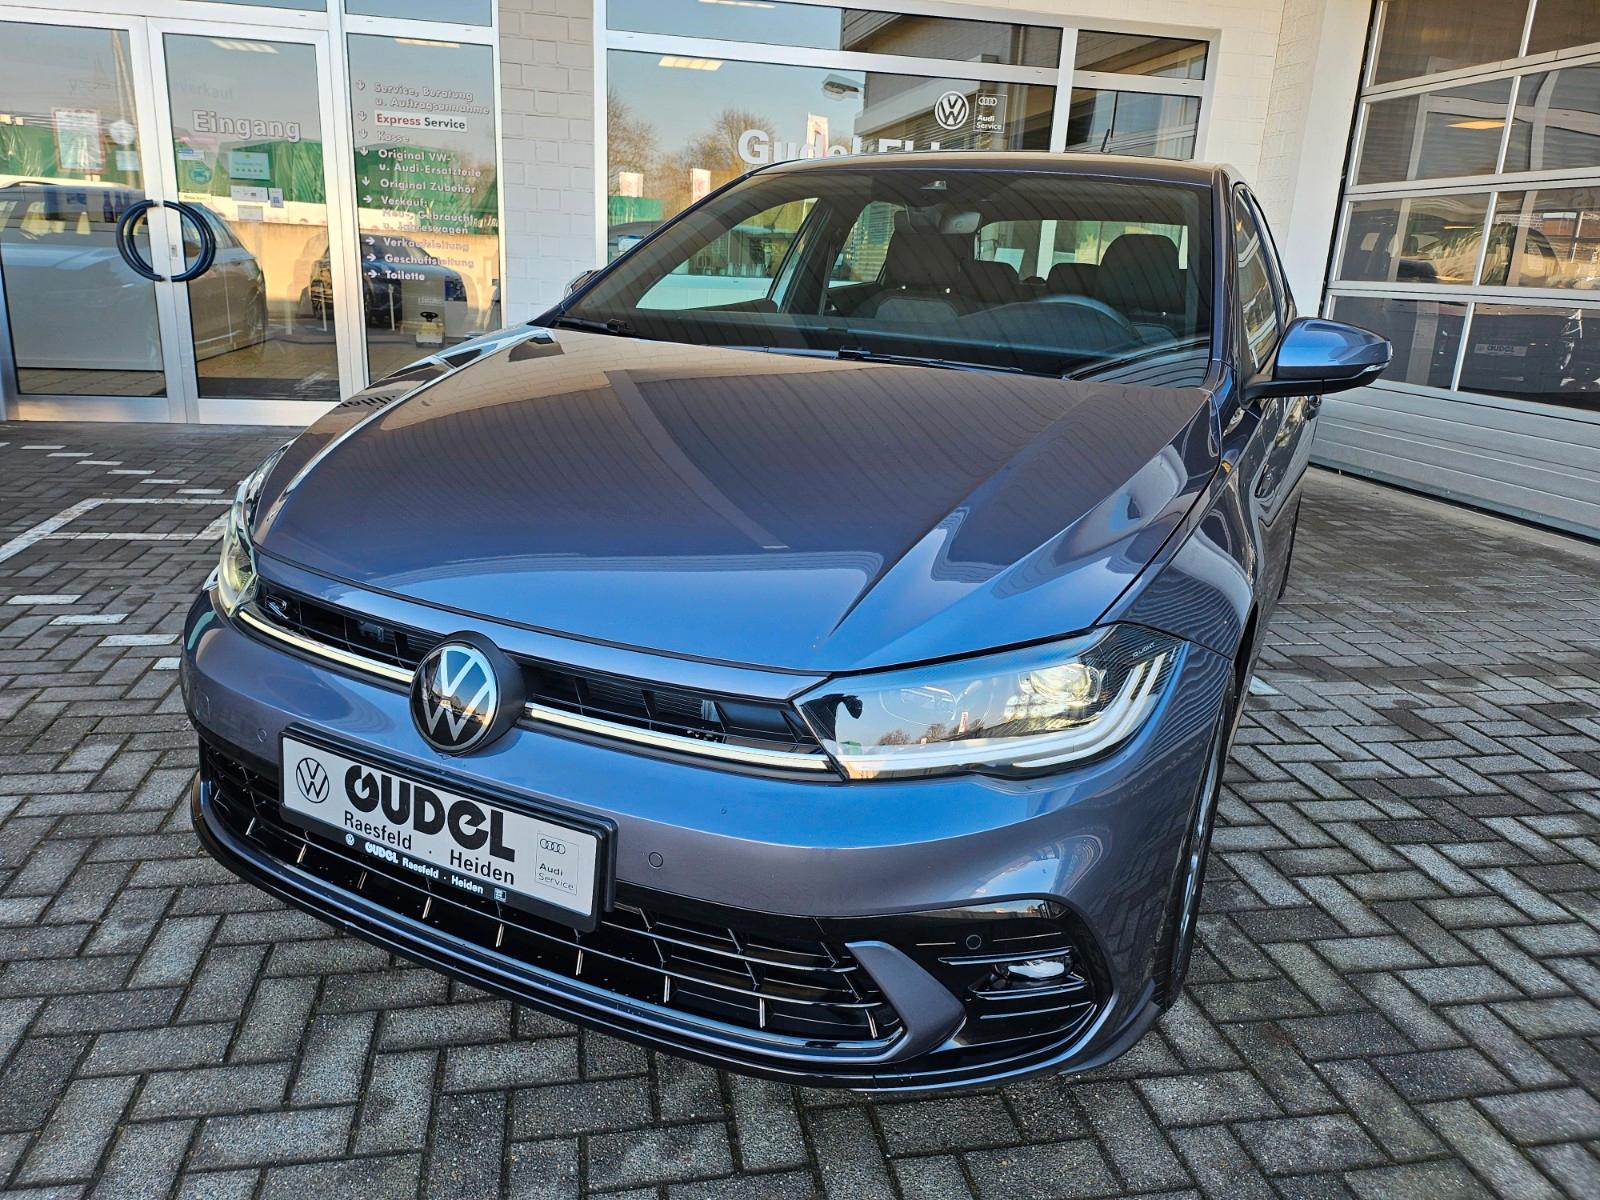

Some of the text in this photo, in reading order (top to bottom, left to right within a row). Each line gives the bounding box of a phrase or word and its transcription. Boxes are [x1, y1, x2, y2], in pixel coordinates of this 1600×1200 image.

[375, 82, 474, 102] Service, Beratung
[390, 98, 490, 114] Auftragsannahme
[192, 109, 302, 143] Eingang
[376, 113, 466, 130] Express Service
[976, 121, 1002, 130] Service
[977, 114, 996, 122] Audi
[377, 130, 410, 143] Kasse
[378, 149, 451, 162] Original VW-
[379, 162, 481, 178] u. Audi-Ersatzteile
[380, 178, 476, 194] Original Zubehör
[381, 195, 428, 207] Verkauf:
[398, 222, 469, 235] Jahreswagen
[384, 237, 470, 253] Verkaufsleitung
[385, 270, 426, 281] Toilette
[344, 810, 515, 886] Raesfeld Heiden
[402, 856, 440, 879] Raesfeld
[451, 875, 484, 895] Heiden
[539, 863, 563, 877] Audi
[538, 872, 574, 891] Service
